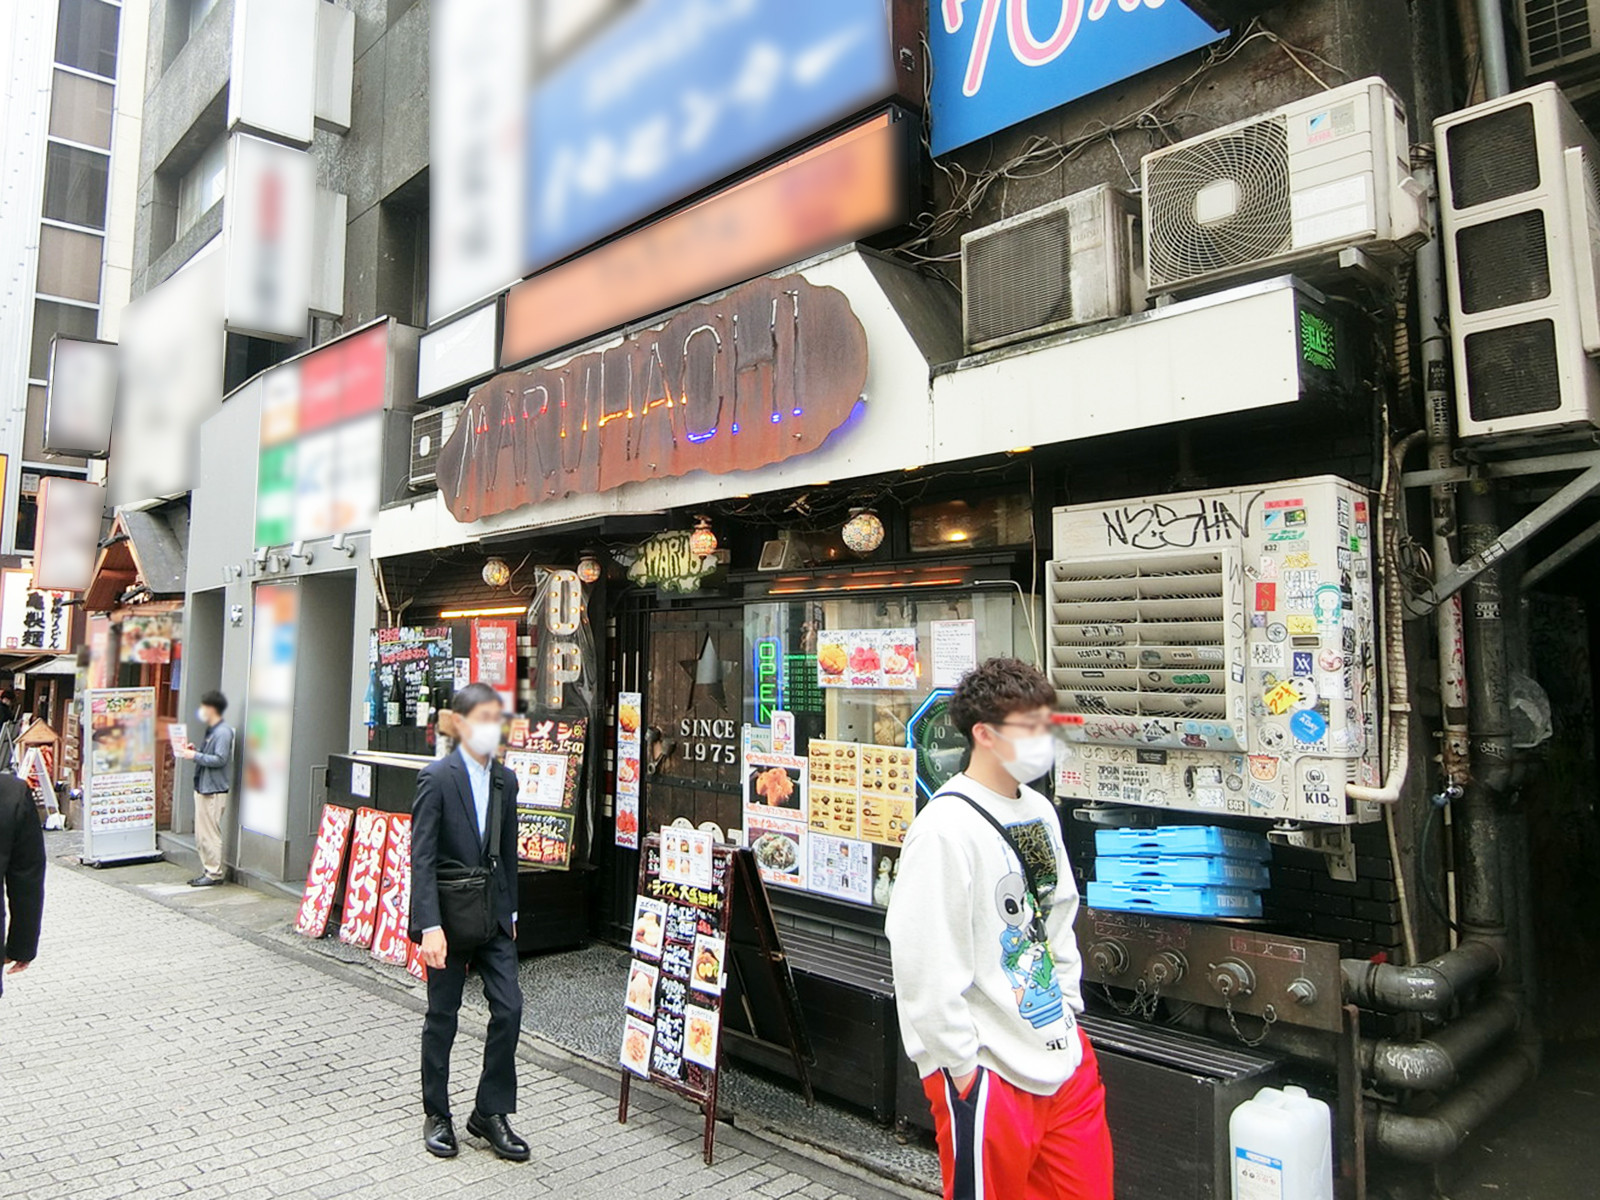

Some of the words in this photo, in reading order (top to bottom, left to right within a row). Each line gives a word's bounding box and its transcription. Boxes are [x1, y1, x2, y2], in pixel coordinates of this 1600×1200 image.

[21, 578, 45, 648] 亀製麺
[759, 642, 776, 723] OPEN
[680, 718, 735, 739] SINCE
[683, 742, 736, 764] 1975
